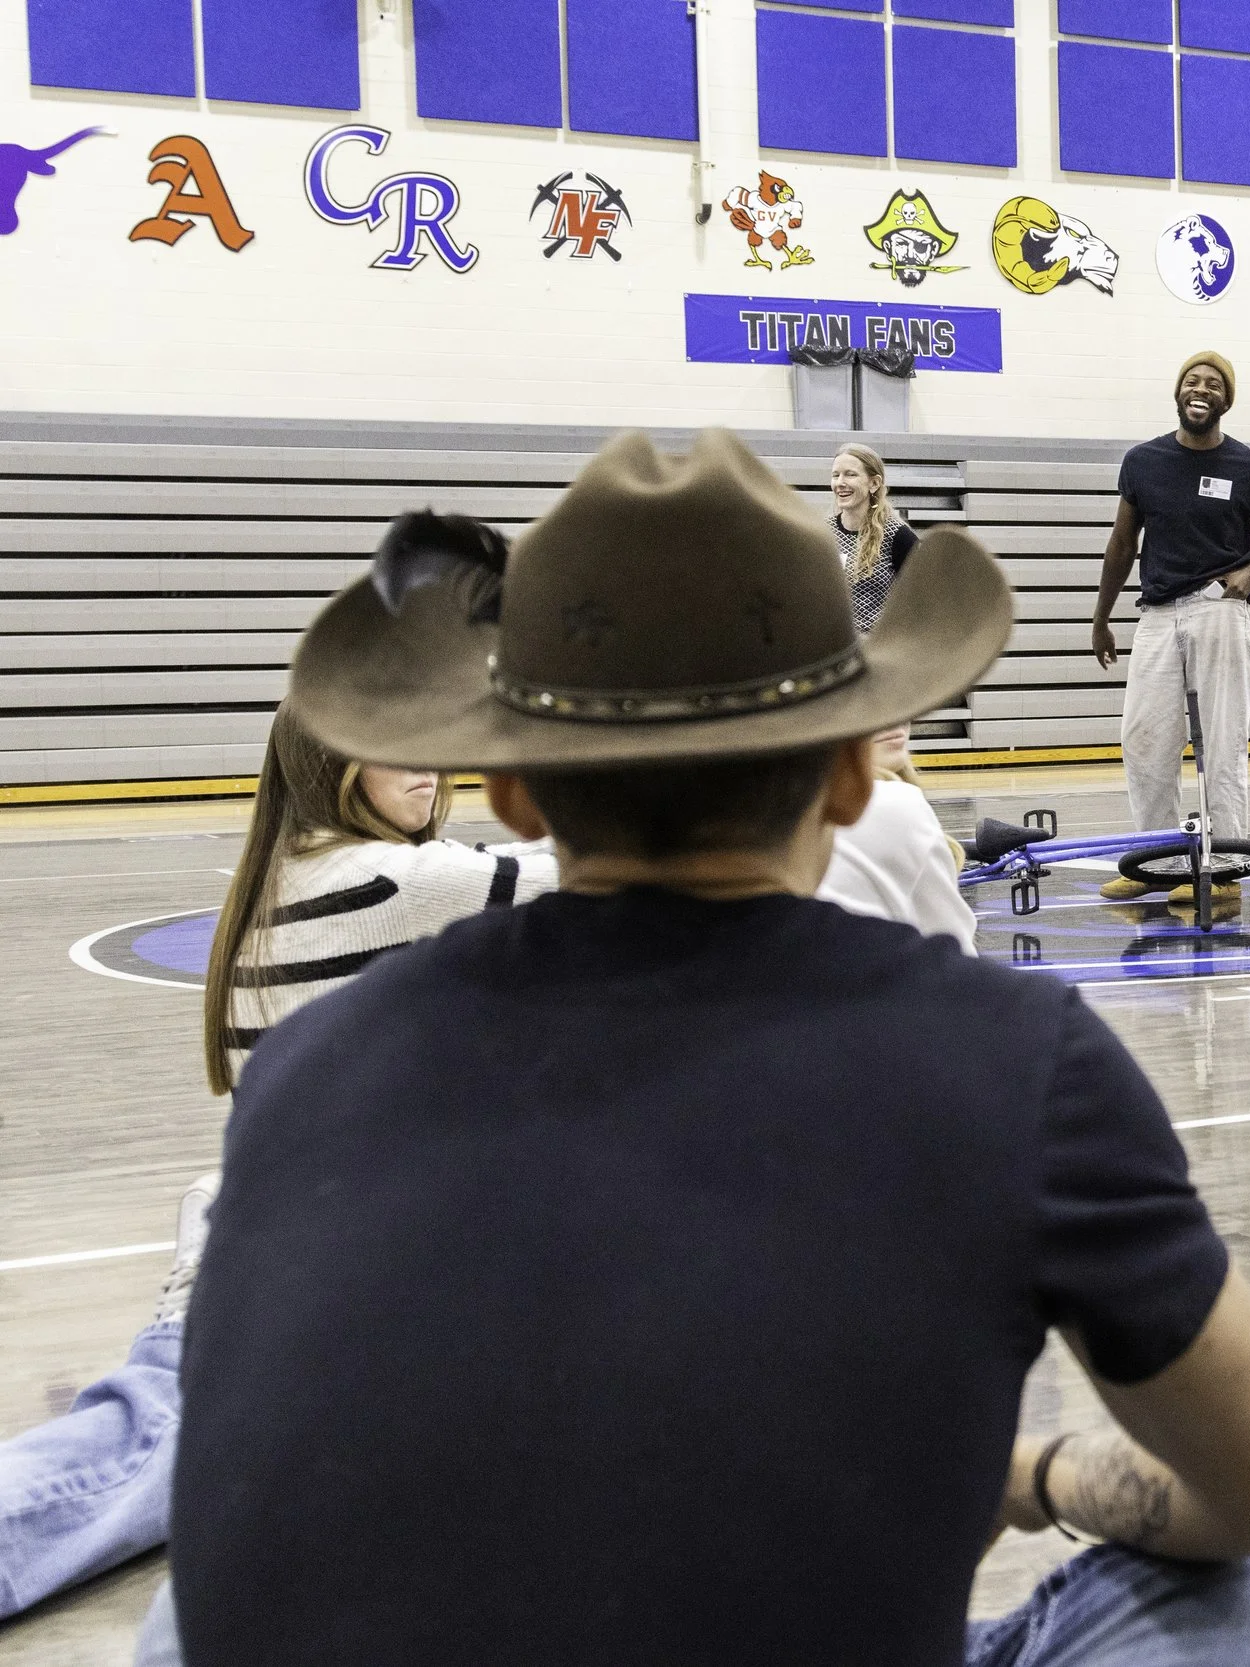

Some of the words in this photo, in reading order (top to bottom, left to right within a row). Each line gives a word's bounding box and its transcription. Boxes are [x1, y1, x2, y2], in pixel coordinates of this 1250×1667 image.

[303, 123, 479, 273] CR
[541, 189, 621, 259] NF
[757, 210, 777, 222] GV
[739, 310, 851, 351] TITAN
[865, 316, 956, 358] FANS
